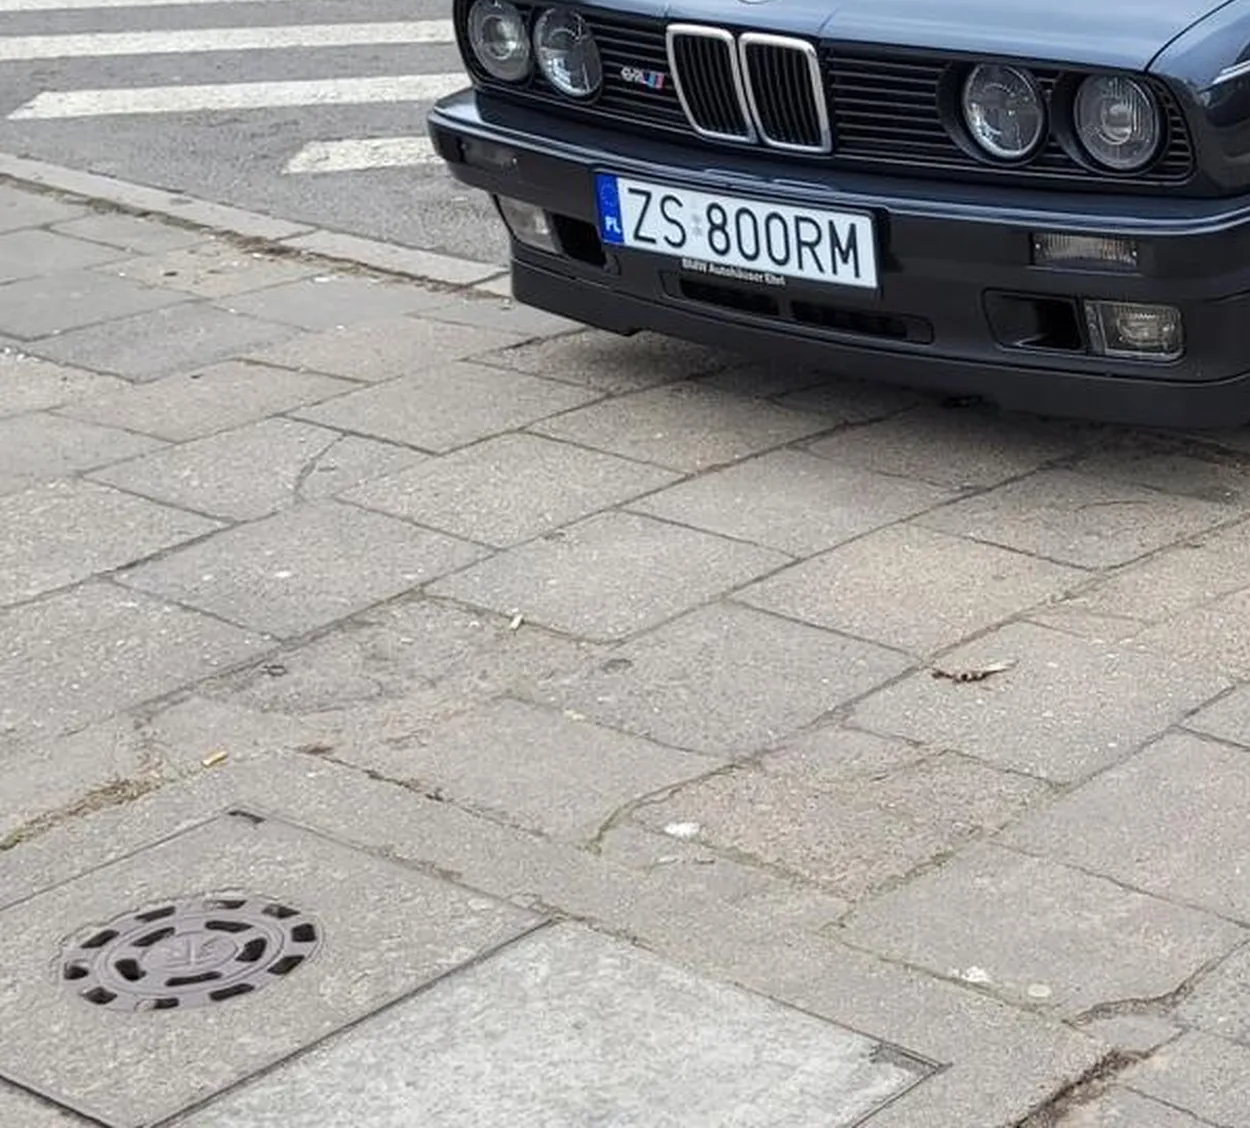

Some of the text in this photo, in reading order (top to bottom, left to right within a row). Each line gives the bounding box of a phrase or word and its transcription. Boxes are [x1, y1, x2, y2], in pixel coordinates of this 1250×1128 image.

[604, 216, 621, 233] PL
[628, 187, 860, 278] ZS 800RM
